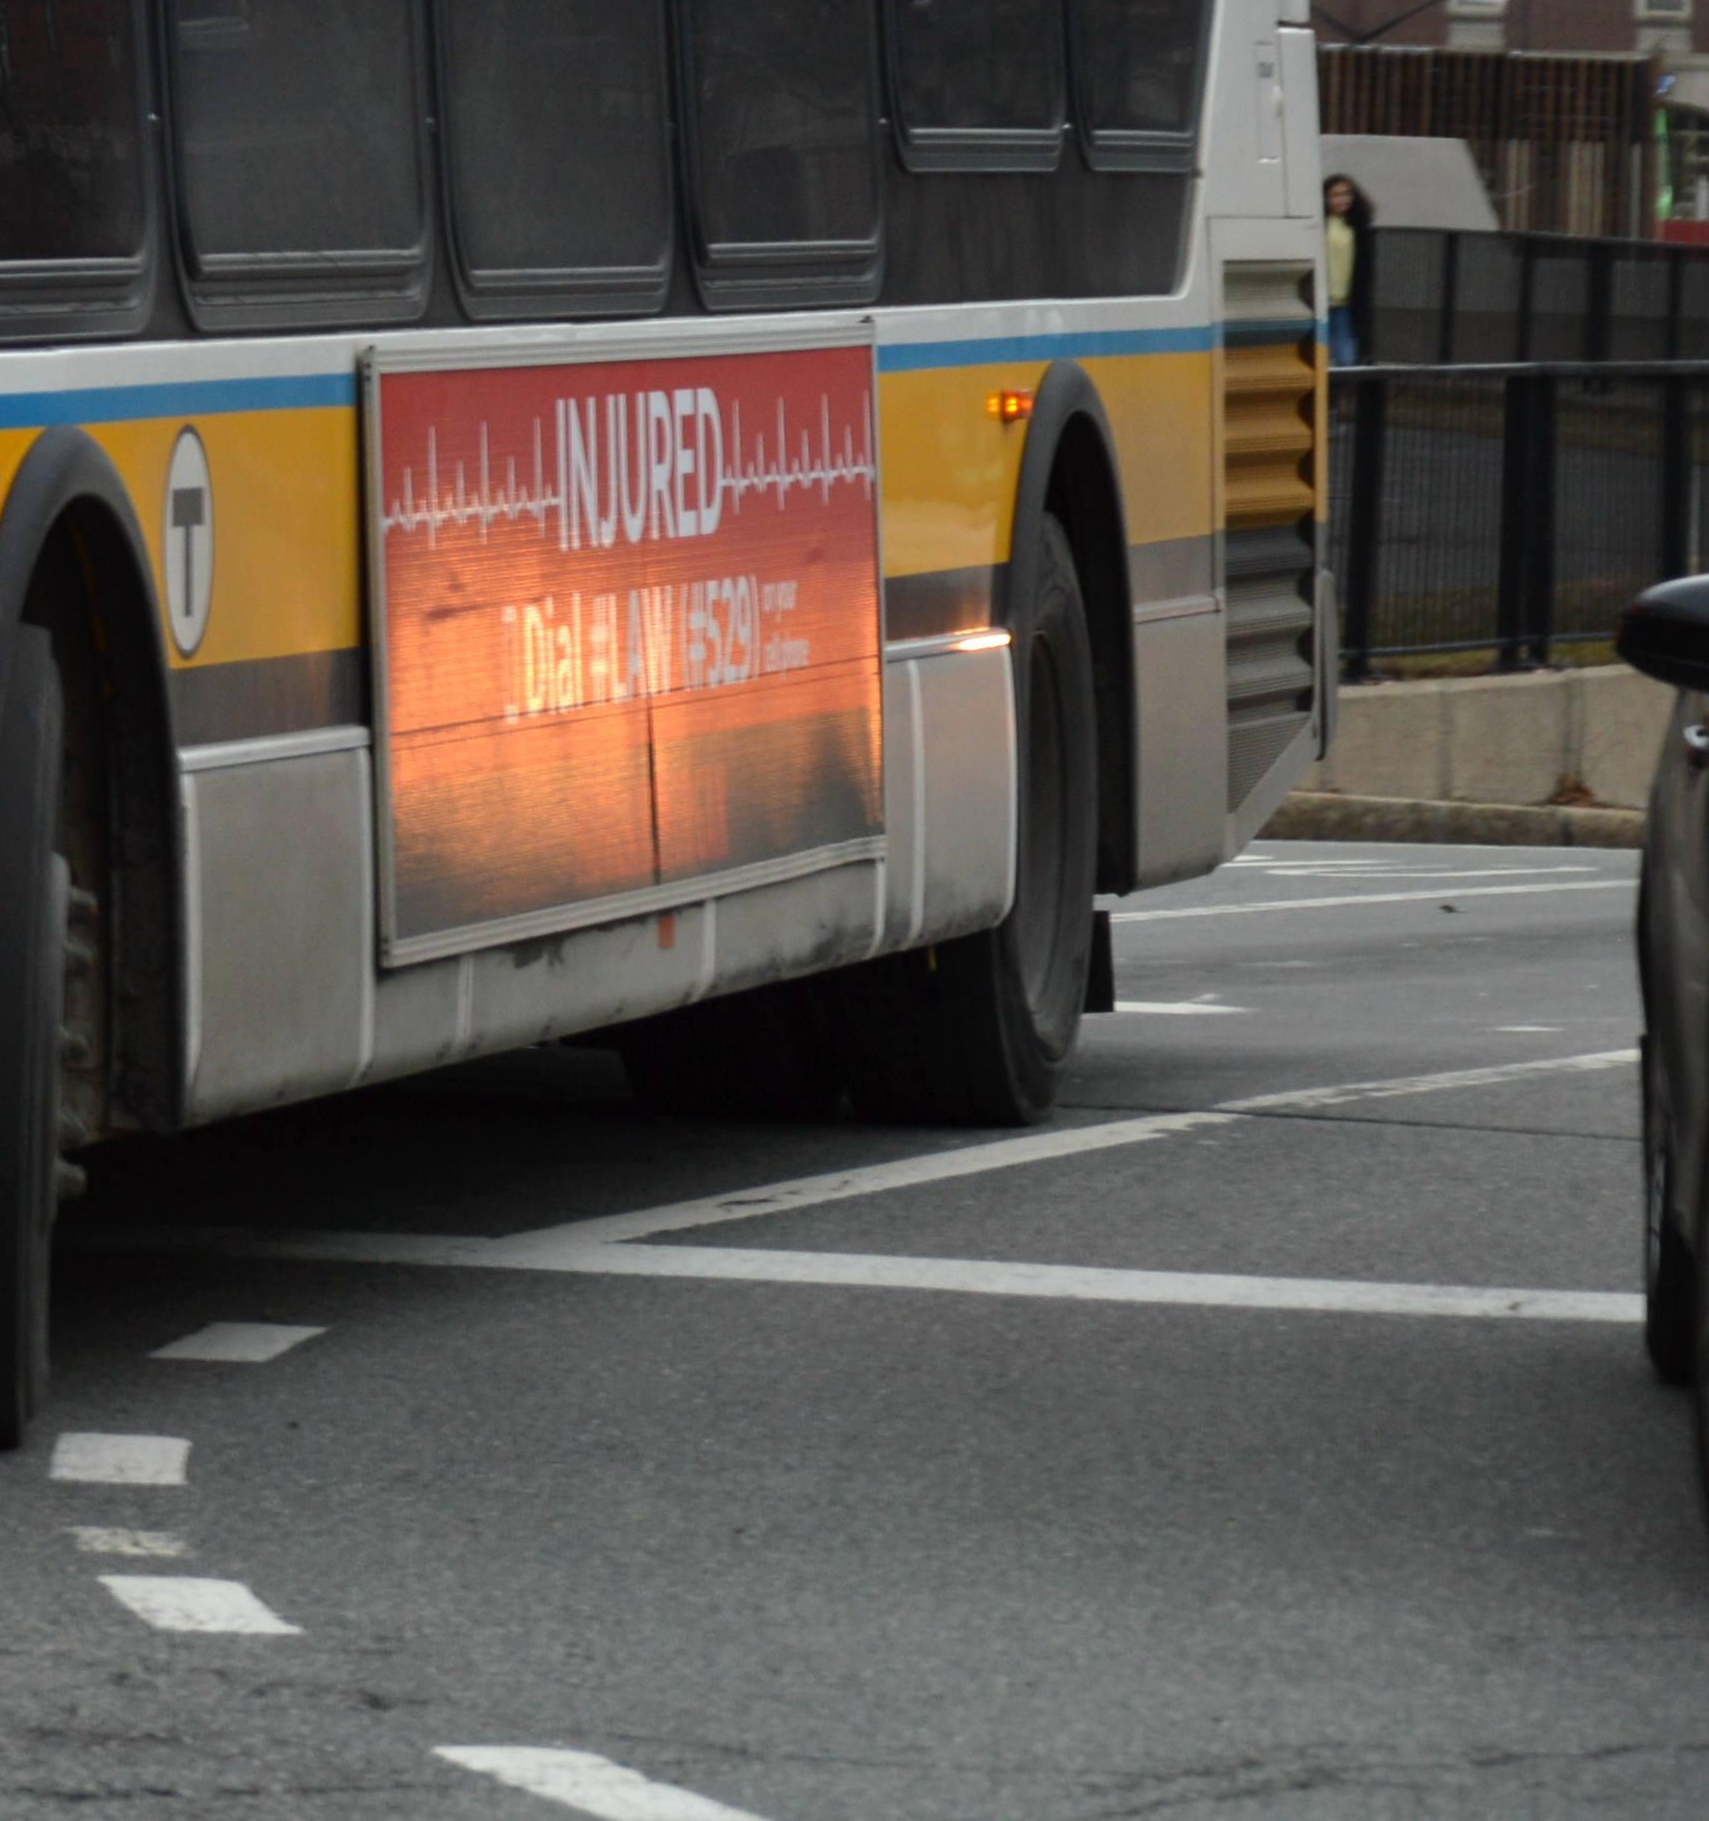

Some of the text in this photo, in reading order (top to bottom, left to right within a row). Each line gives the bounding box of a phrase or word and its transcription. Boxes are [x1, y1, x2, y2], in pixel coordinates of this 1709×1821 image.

[556, 388, 724, 554] INJURED
[523, 591, 583, 718] Dial
[589, 585, 673, 703] #LAW
[679, 574, 761, 692] (#529)
